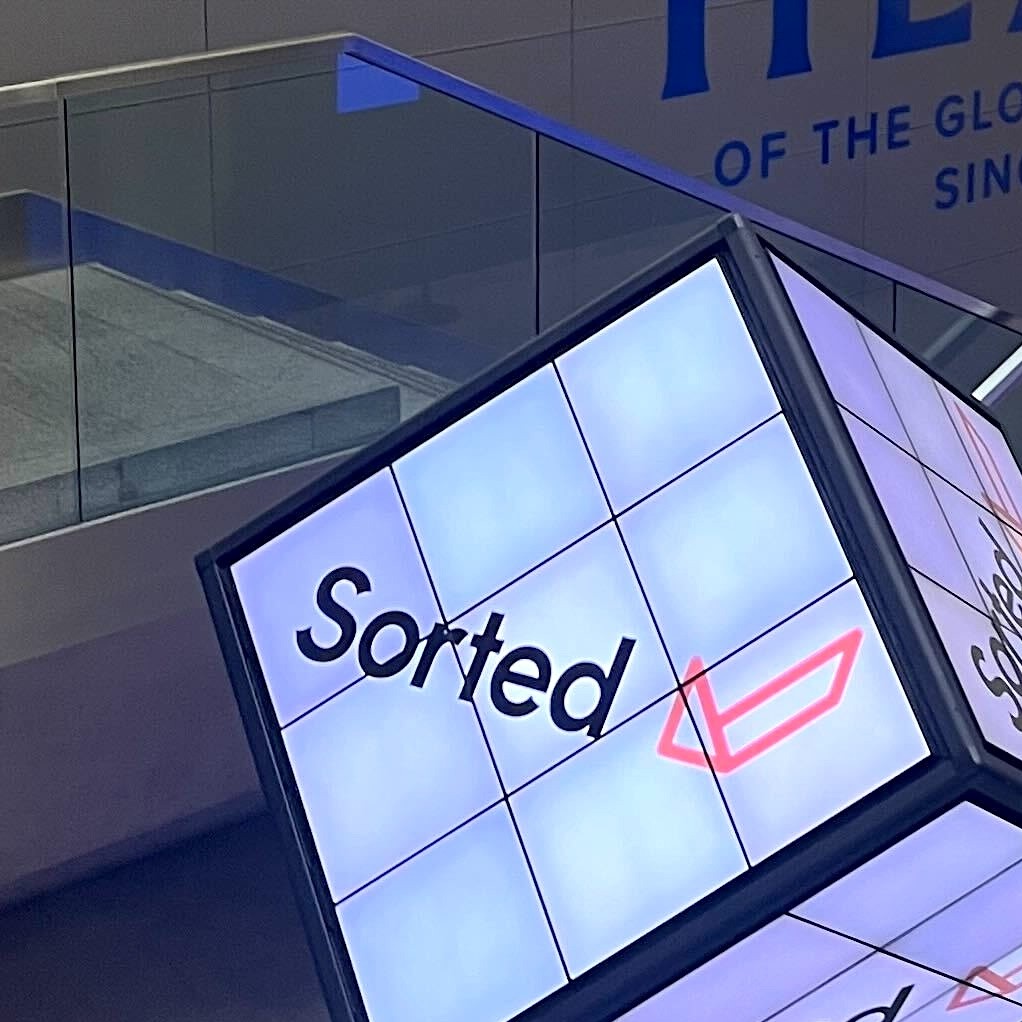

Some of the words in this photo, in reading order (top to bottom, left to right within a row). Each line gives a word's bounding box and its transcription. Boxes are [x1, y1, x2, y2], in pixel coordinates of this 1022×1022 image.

[714, 131, 787, 187] OF
[812, 105, 912, 165] THE
[296, 565, 636, 738] Sorted
